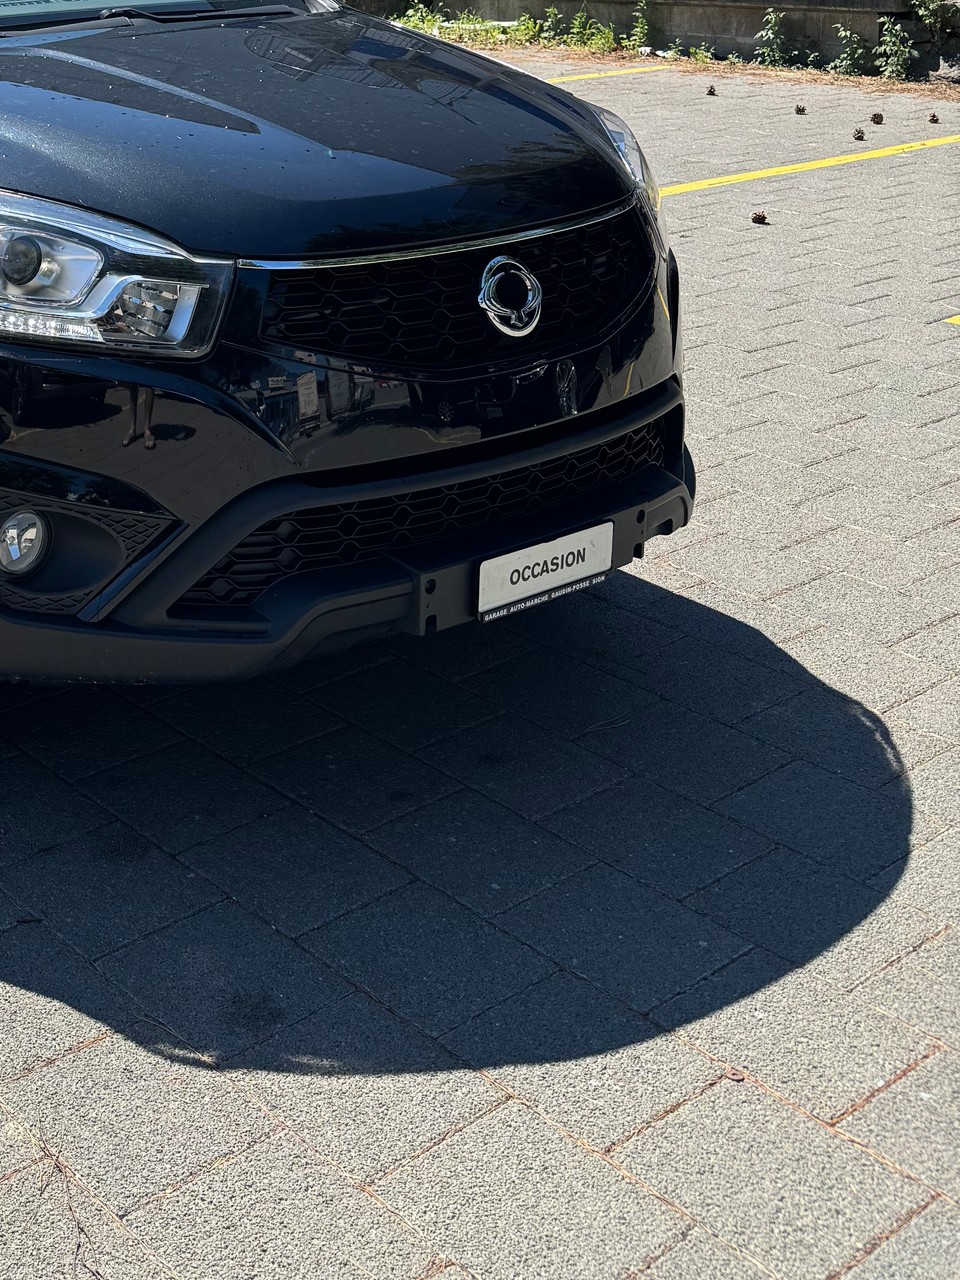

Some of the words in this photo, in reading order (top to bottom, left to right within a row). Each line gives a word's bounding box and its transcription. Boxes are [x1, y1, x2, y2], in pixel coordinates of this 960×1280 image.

[510, 548, 586, 585] OCCASION
[484, 609, 508, 621] GARAGE
[592, 575, 605, 584] SION
